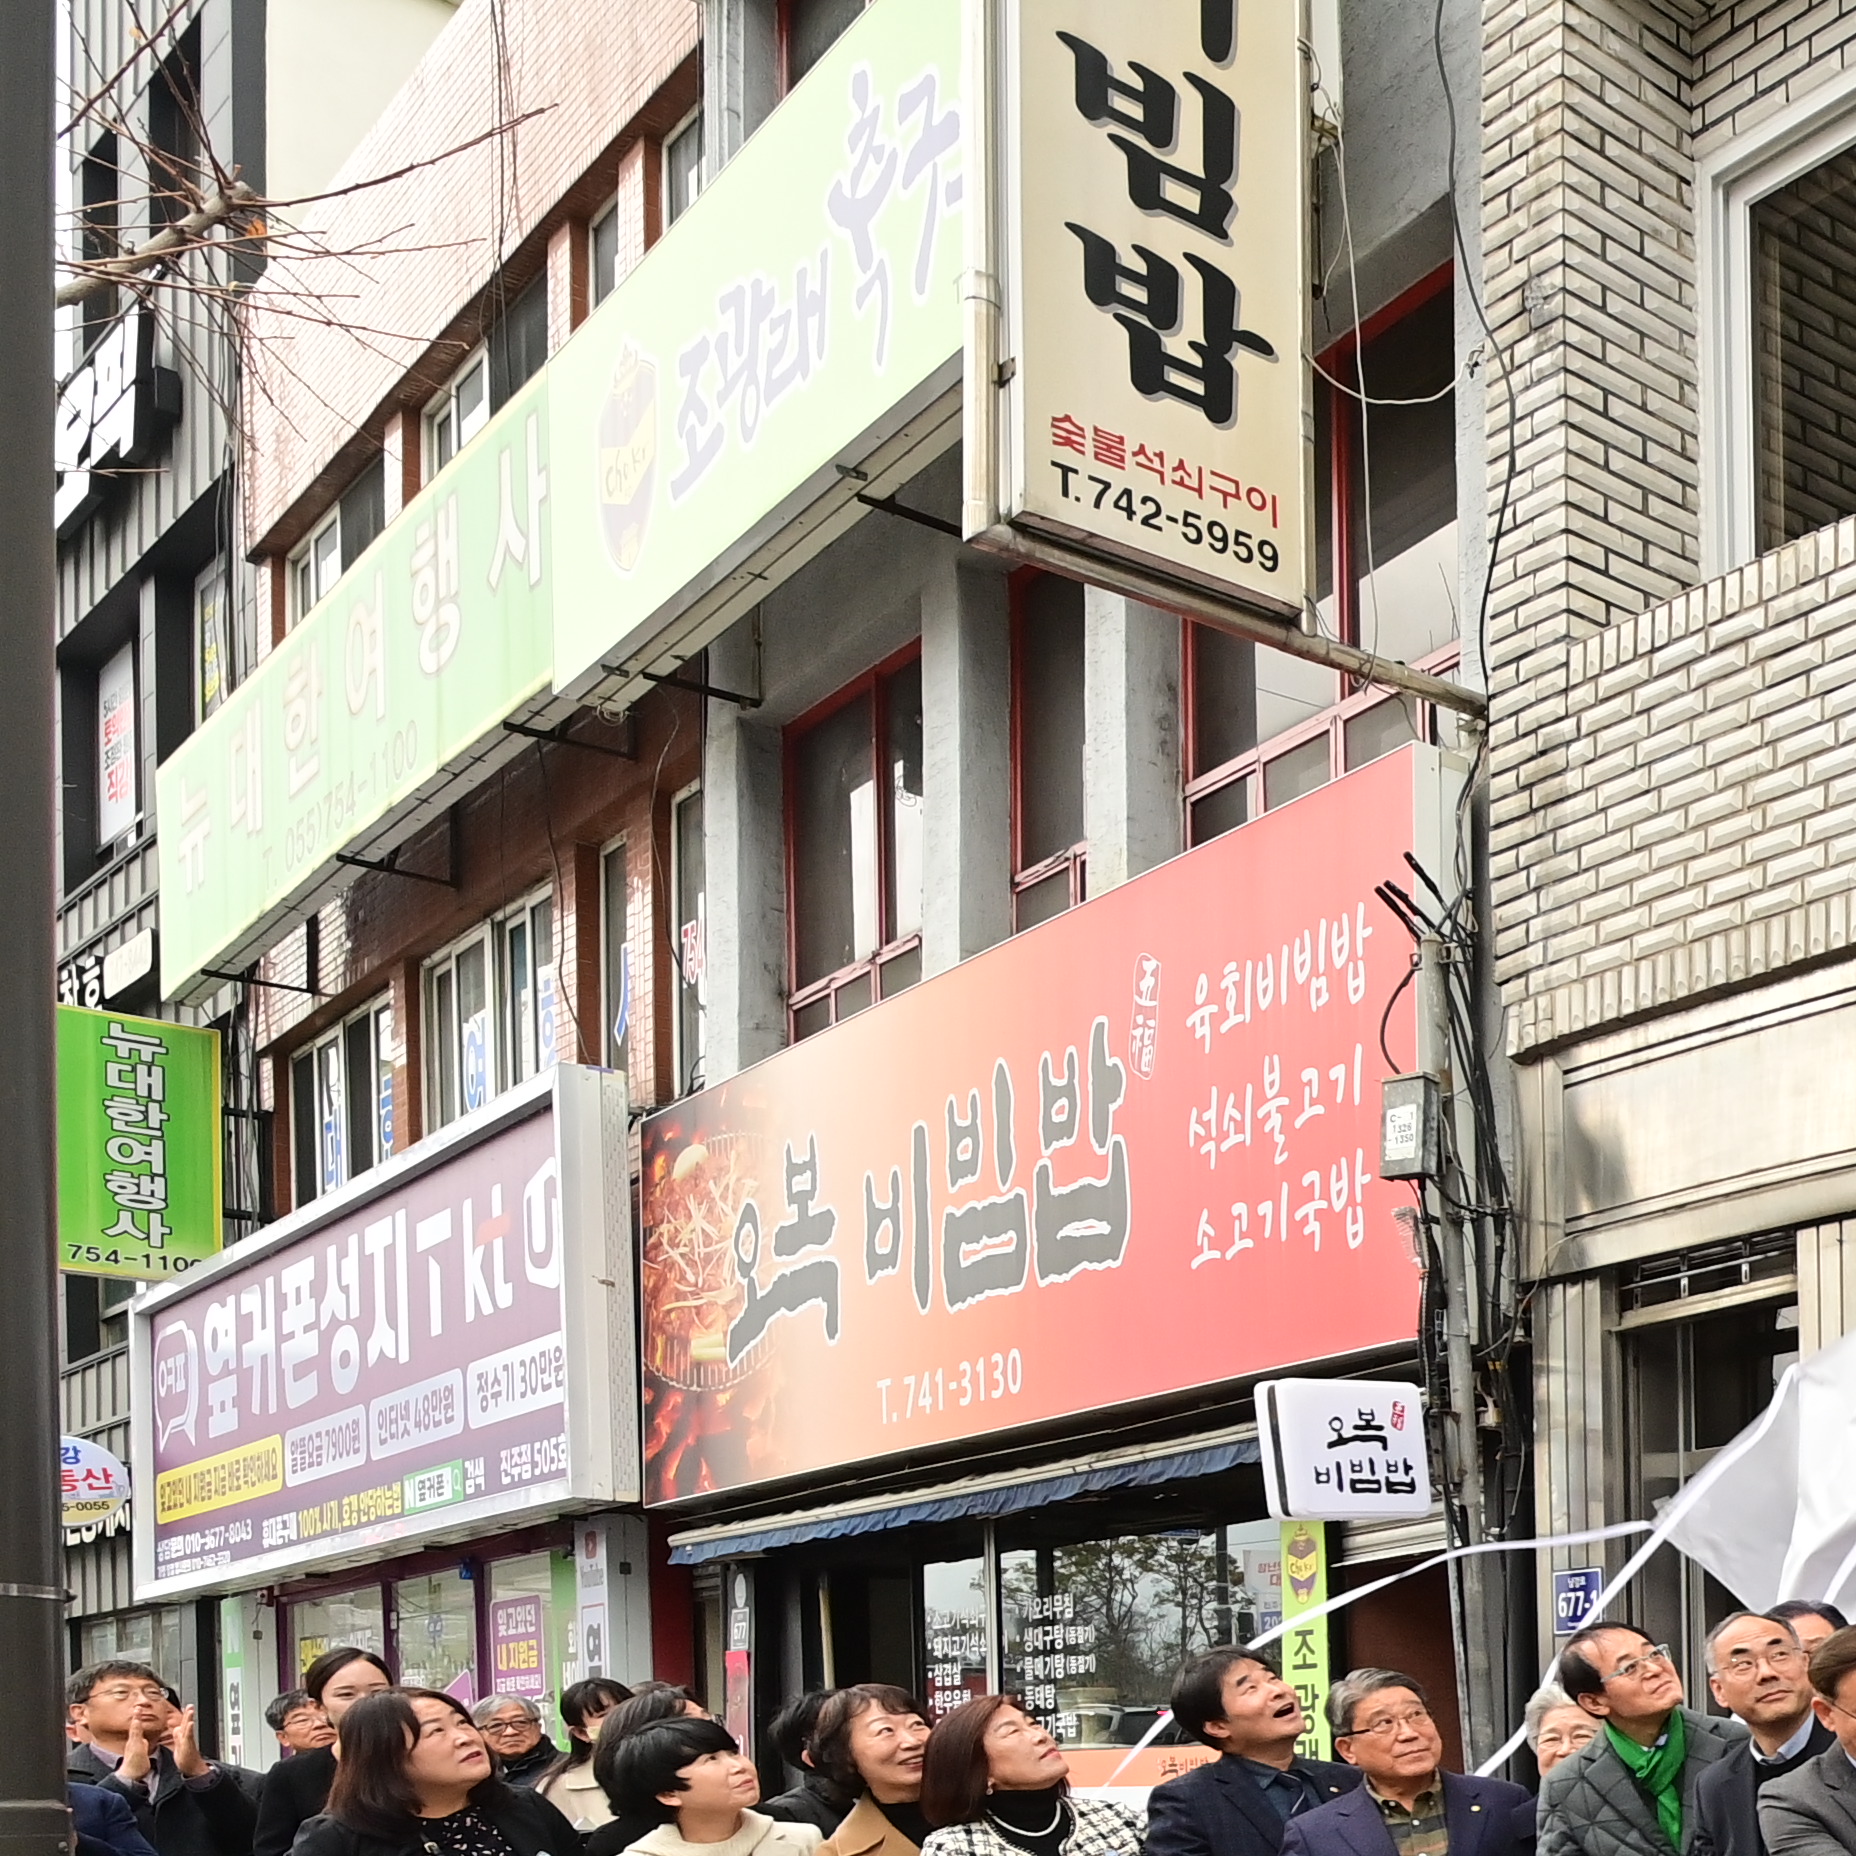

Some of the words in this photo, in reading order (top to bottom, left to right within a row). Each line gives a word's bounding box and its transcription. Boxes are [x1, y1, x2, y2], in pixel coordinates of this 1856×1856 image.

[670, 244, 829, 503] 조광래
[827, 70, 963, 368] 축구
[1050, 412, 1279, 529] 숯불석쇠구이
[1050, 461, 1280, 573] T.742-5959
[177, 409, 550, 896] 뉴대한여행사
[1186, 902, 1373, 1054] 육회비빔밥
[1189, 1042, 1362, 1169] 석쇠불고기
[101, 1021, 172, 1250] 뉴대한여행사
[727, 1130, 841, 1369] 오복
[864, 1016, 1132, 1315] 비빔밥
[1190, 1147, 1373, 1270] 소고기국밥
[203, 1208, 410, 1439] 옆귀폰성지
[378, 1407, 410, 1447] 인터넷
[414, 1383, 455, 1432] 48만원
[477, 1365, 515, 1414] 정수기
[324, 1416, 361, 1467] 7900원
[1327, 1408, 1388, 1451] 오복
[464, 1456, 485, 1495] 검색
[500, 1443, 531, 1485] 진주점
[1314, 1457, 1416, 1494] 비빔밥
[497, 1604, 536, 1637] 잊고있던
[1023, 1593, 1074, 1622] 가오리무침
[497, 1643, 508, 1671] 내
[508, 1639, 538, 1670] 지원금
[1023, 1623, 1064, 1653] 생대구탕
[934, 1661, 962, 1687] 삼겹살
[1024, 1684, 1056, 1711] 동태탕
